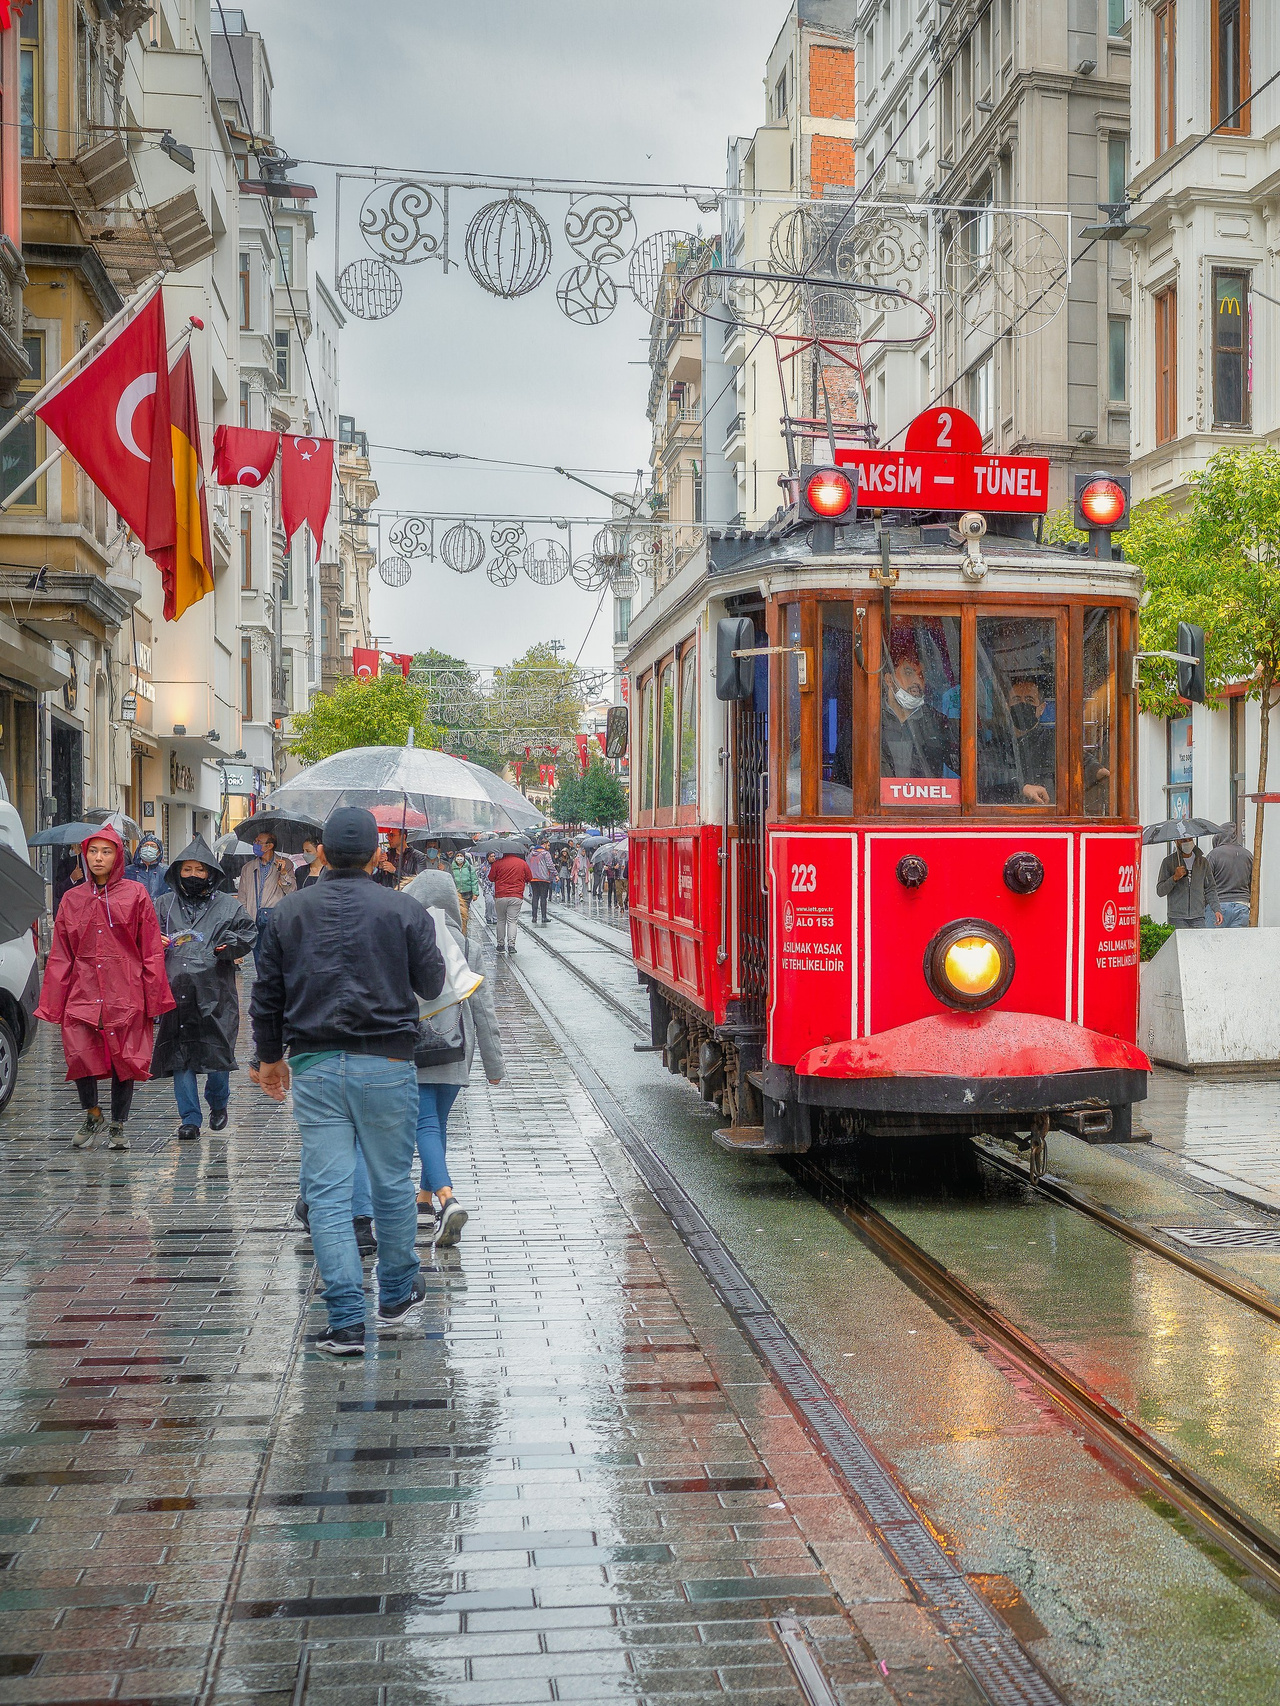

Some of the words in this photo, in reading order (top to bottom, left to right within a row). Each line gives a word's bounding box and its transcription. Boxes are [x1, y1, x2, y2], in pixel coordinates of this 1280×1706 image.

[936, 412, 953, 448] 2
[974, 459, 1042, 497] TÜNEL
[889, 783, 952, 799] TÜNEL
[791, 864, 817, 892] 223
[1118, 865, 1134, 893] 223
[796, 918, 814, 927] ALO
[816, 918, 834, 927] 153
[1119, 917, 1130, 926] ALO
[783, 942, 812, 954] ASILMAK
[813, 943, 843, 955] YASAK
[1098, 940, 1127, 952] ASILMAK
[782, 958, 789, 969] VE
[789, 957, 844, 972] TEHLİKELİDİR
[1096, 957, 1107, 969] VE
